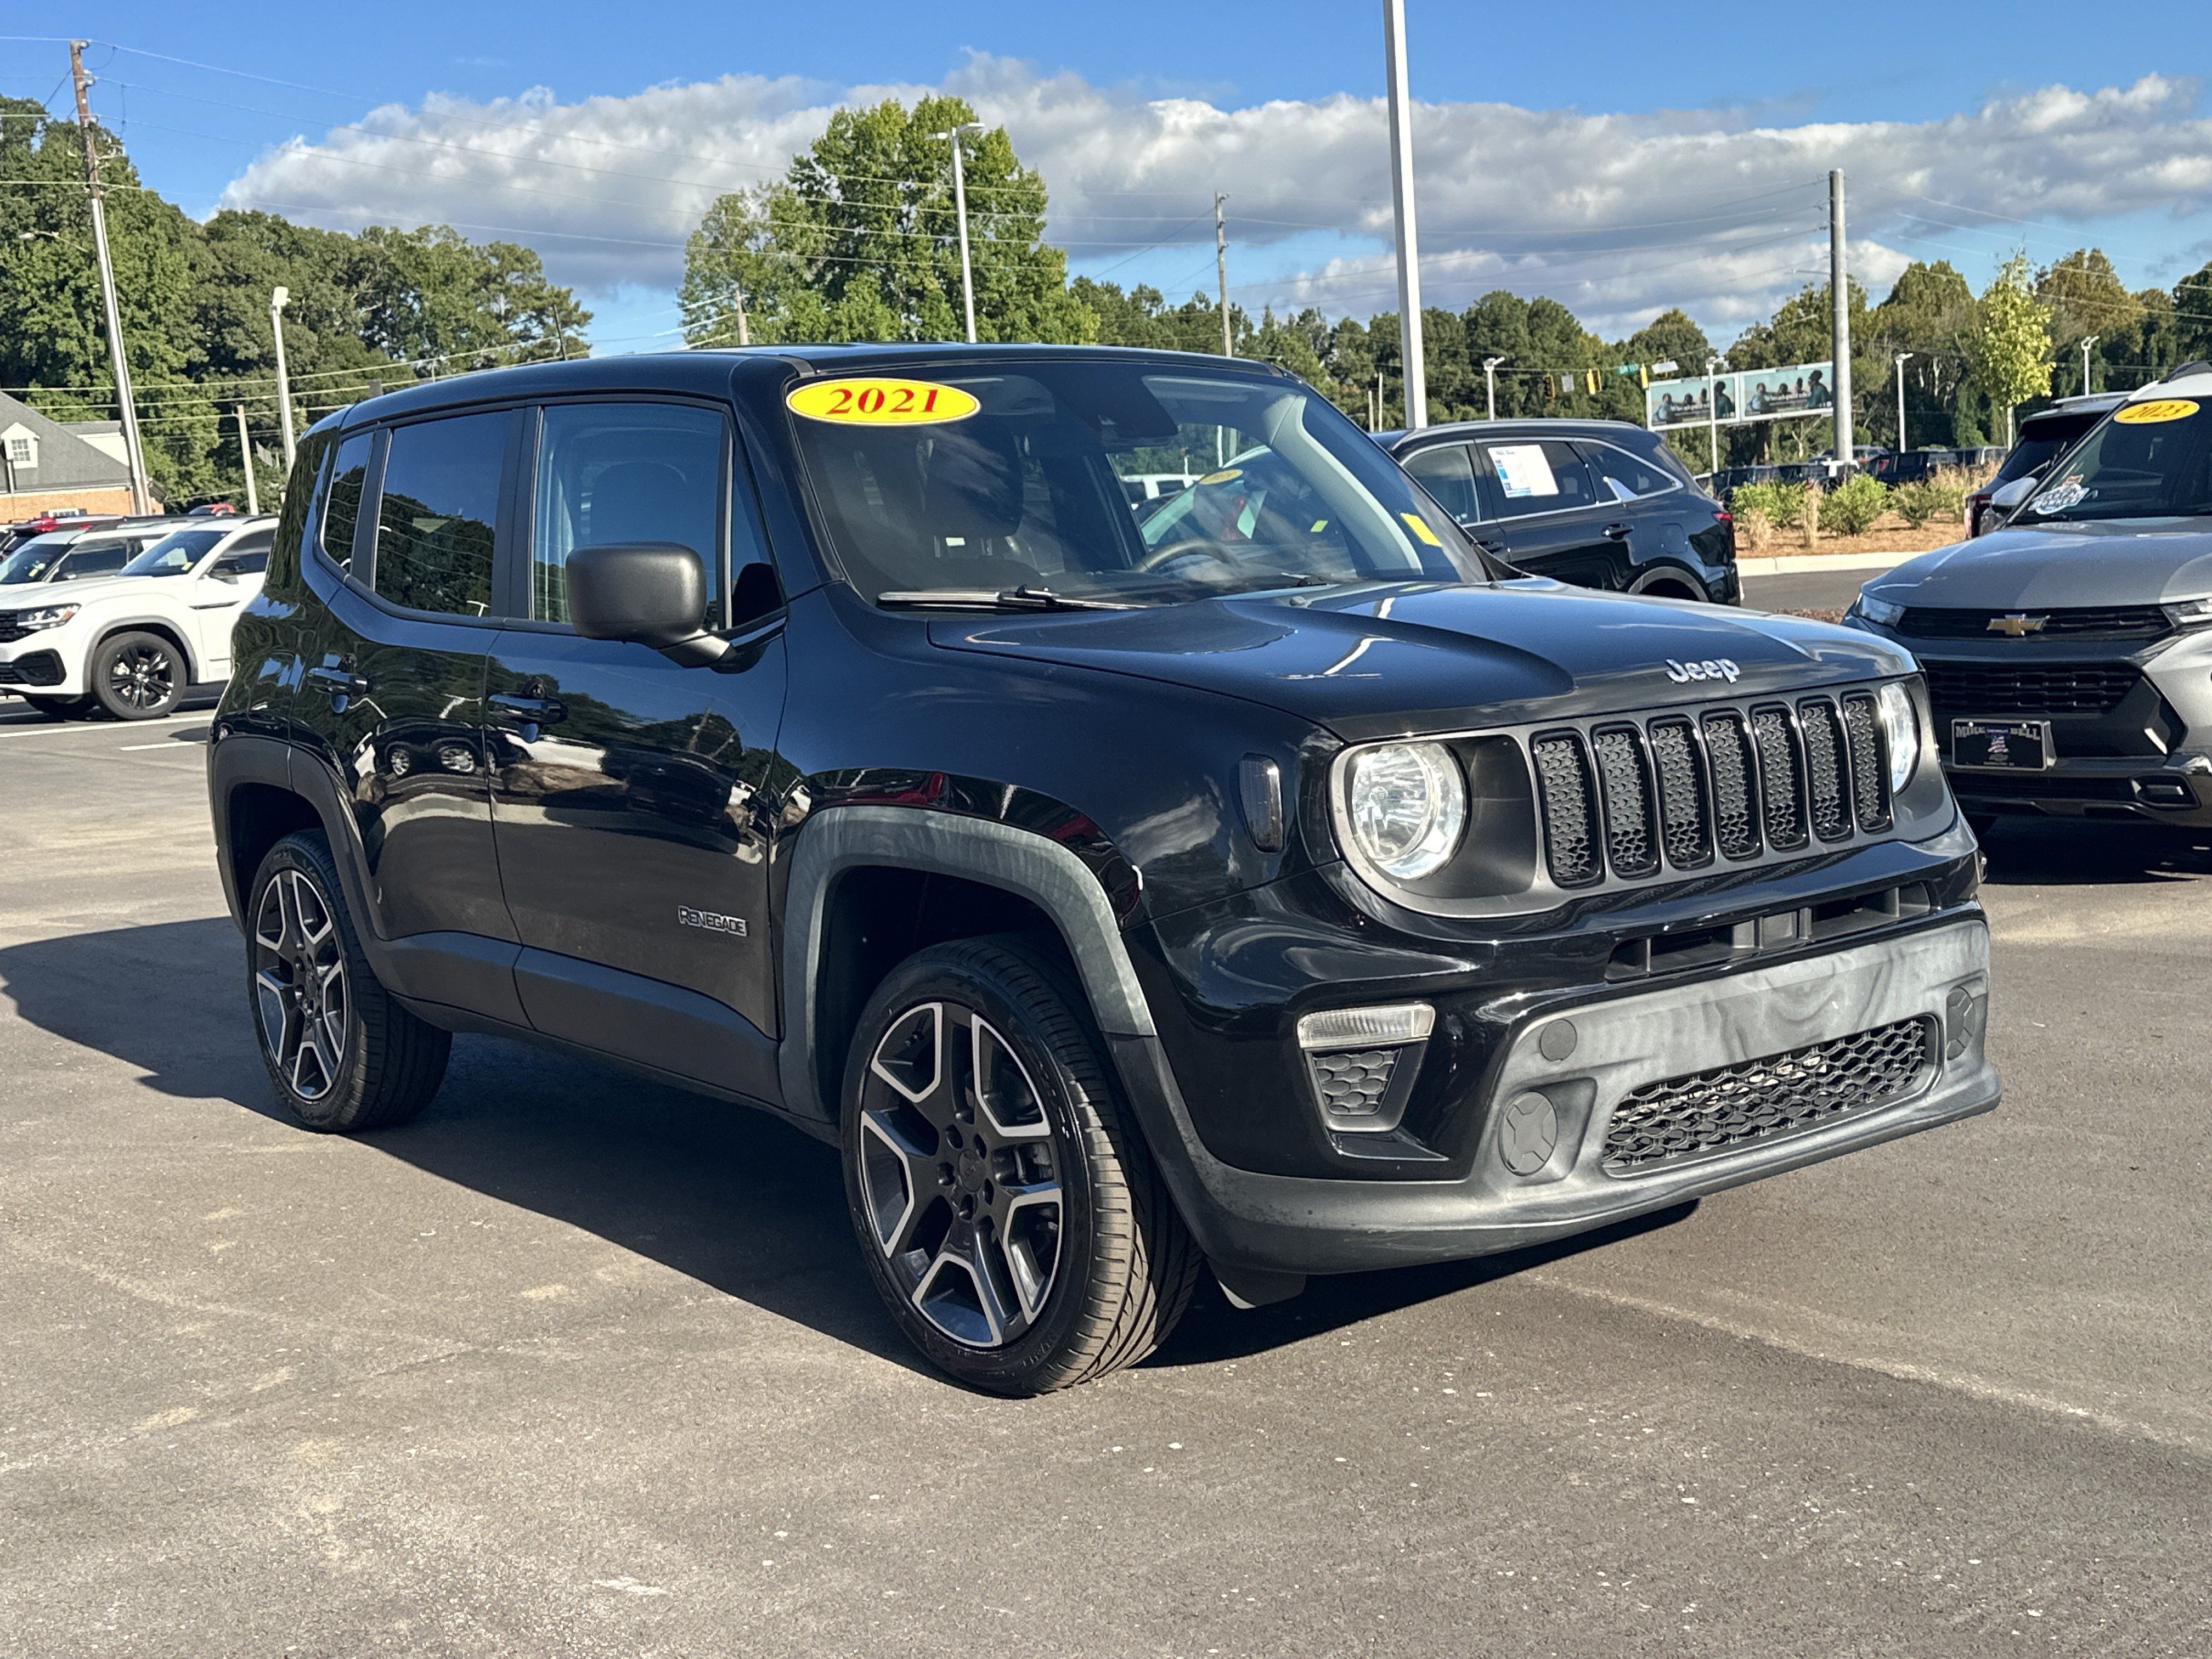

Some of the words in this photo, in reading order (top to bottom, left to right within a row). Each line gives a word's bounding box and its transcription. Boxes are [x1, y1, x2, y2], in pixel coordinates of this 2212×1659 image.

[825, 387, 939, 415] 2021
[2124, 403, 2190, 419] 2023
[1665, 657, 1741, 685] Jeep
[678, 905, 748, 937] RENEGADE
